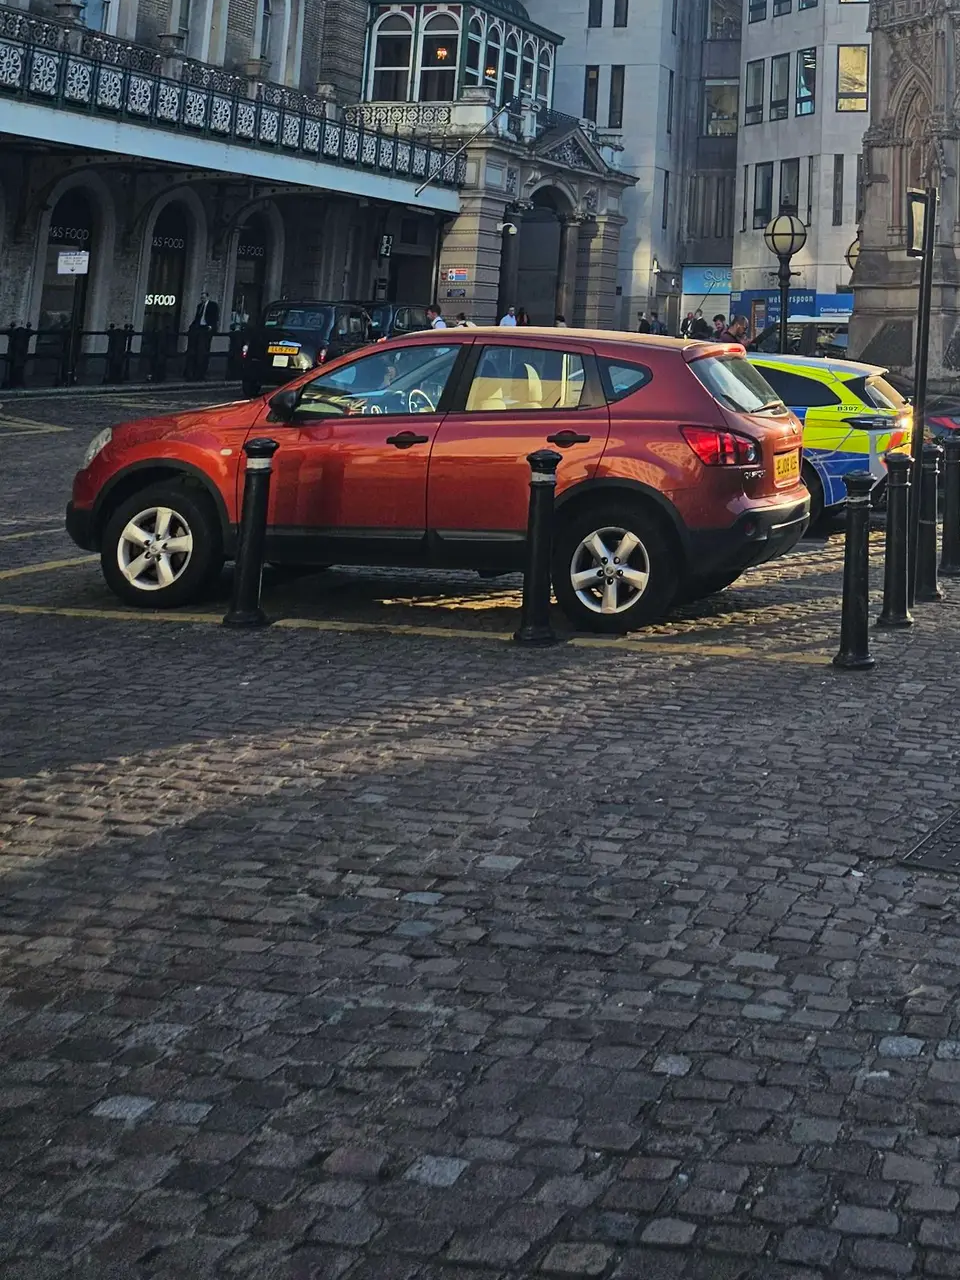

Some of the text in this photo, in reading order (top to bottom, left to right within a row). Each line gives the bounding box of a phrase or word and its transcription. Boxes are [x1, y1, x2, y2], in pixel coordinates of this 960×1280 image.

[66, 227, 89, 240] FOOD
[164, 237, 185, 249] FOOD
[247, 246, 264, 257] FOOD
[154, 295, 176, 306] FOOD
